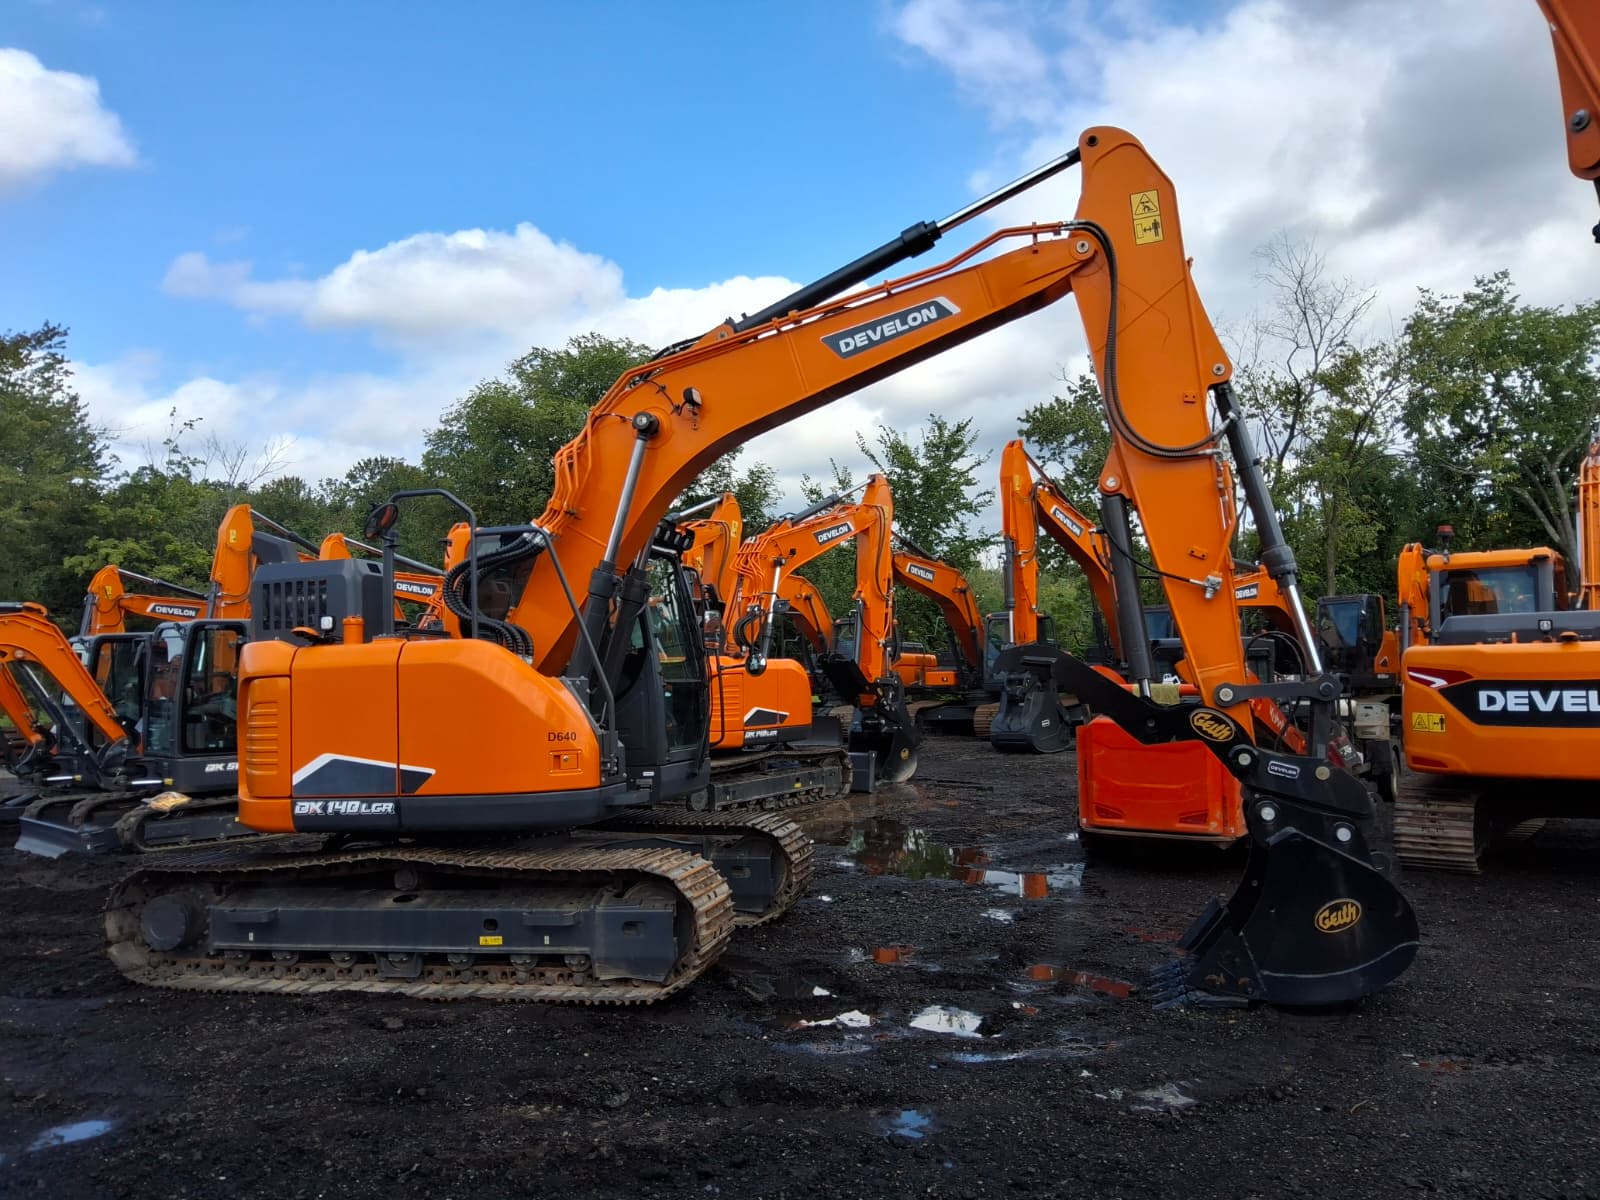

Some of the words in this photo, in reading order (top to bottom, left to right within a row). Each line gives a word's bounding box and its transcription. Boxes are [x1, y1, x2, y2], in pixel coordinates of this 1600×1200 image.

[839, 306, 938, 353] DEVELON
[817, 525, 849, 543] DEVELON
[396, 582, 433, 595] DEVELON
[155, 606, 196, 617] DEVELON
[547, 732, 577, 742] D640
[1318, 903, 1356, 930] Geith
